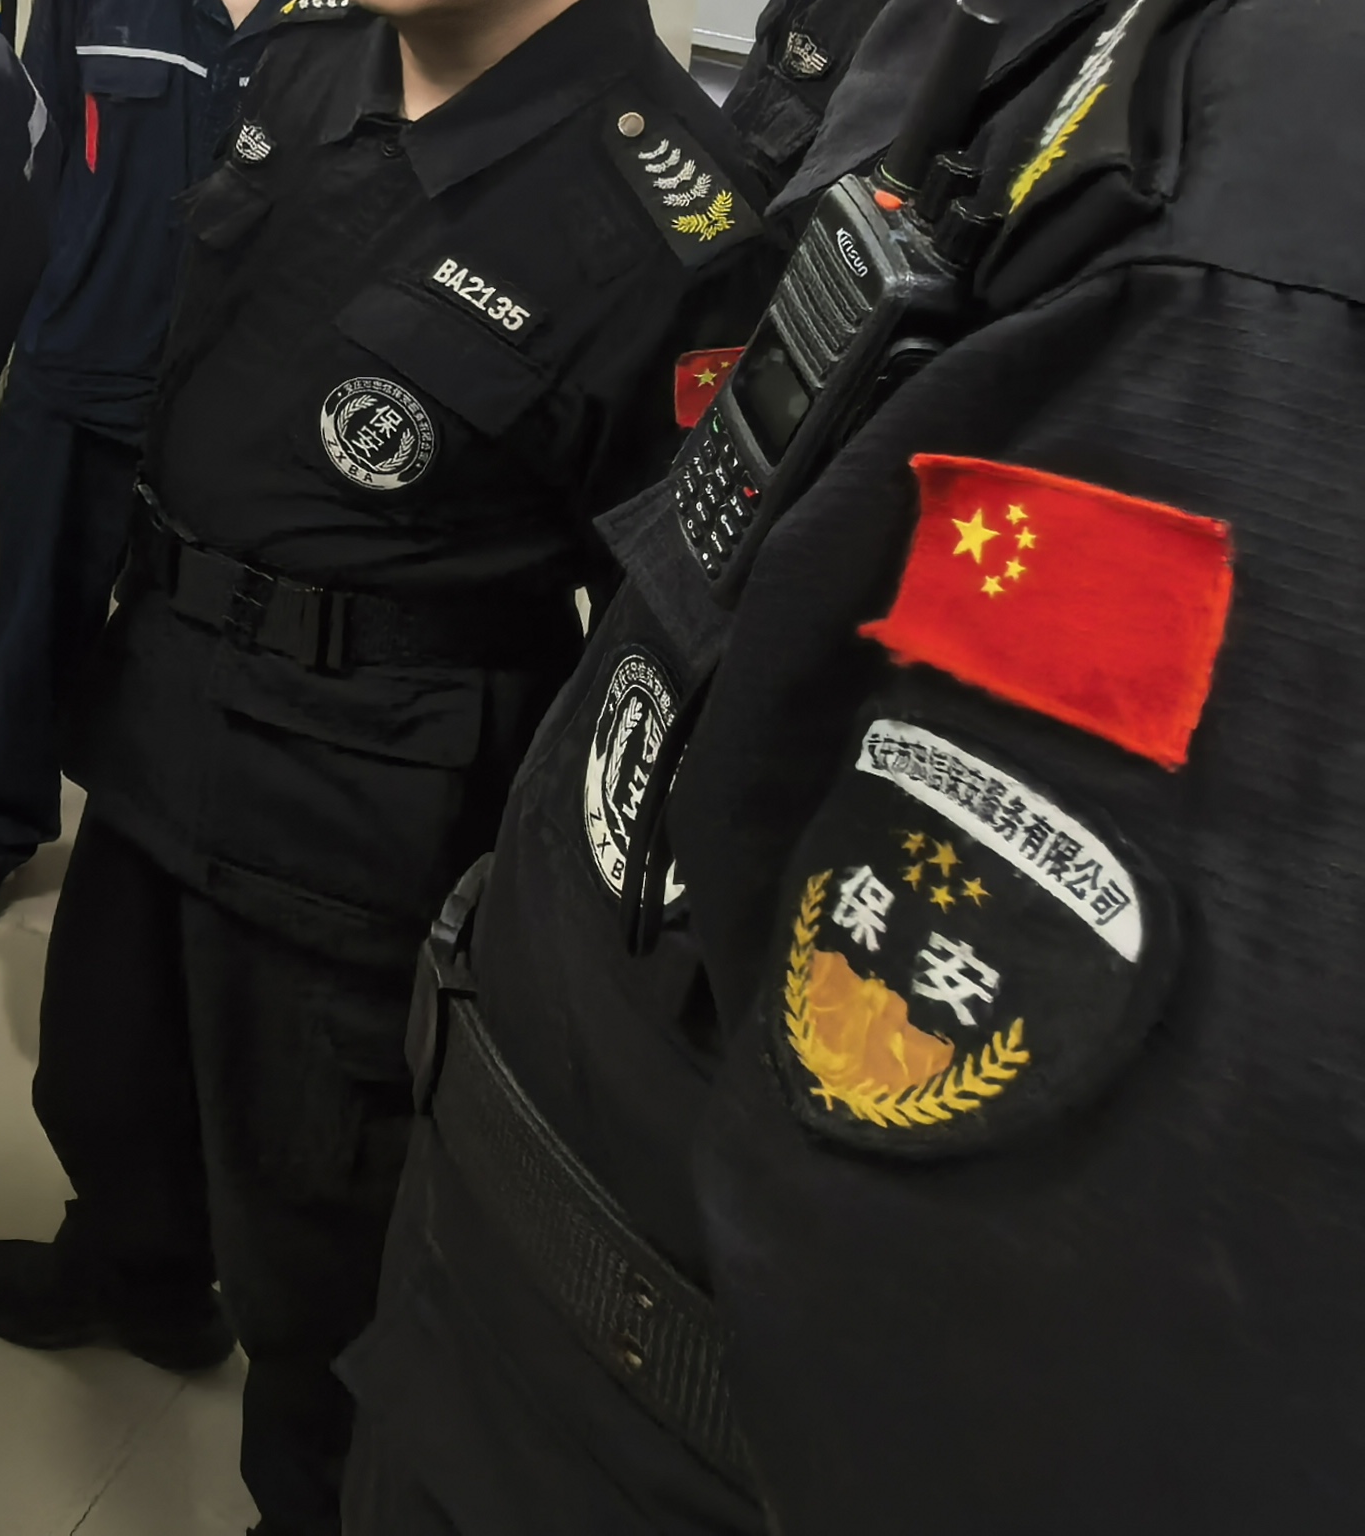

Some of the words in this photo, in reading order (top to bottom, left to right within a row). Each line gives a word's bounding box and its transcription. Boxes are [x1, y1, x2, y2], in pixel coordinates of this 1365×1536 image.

[433, 258, 531, 331] BA2135
[327, 439, 374, 484] ZXBA
[352, 404, 404, 458] 保安
[587, 807, 625, 881] ZXB
[832, 864, 1000, 1026] 保安
